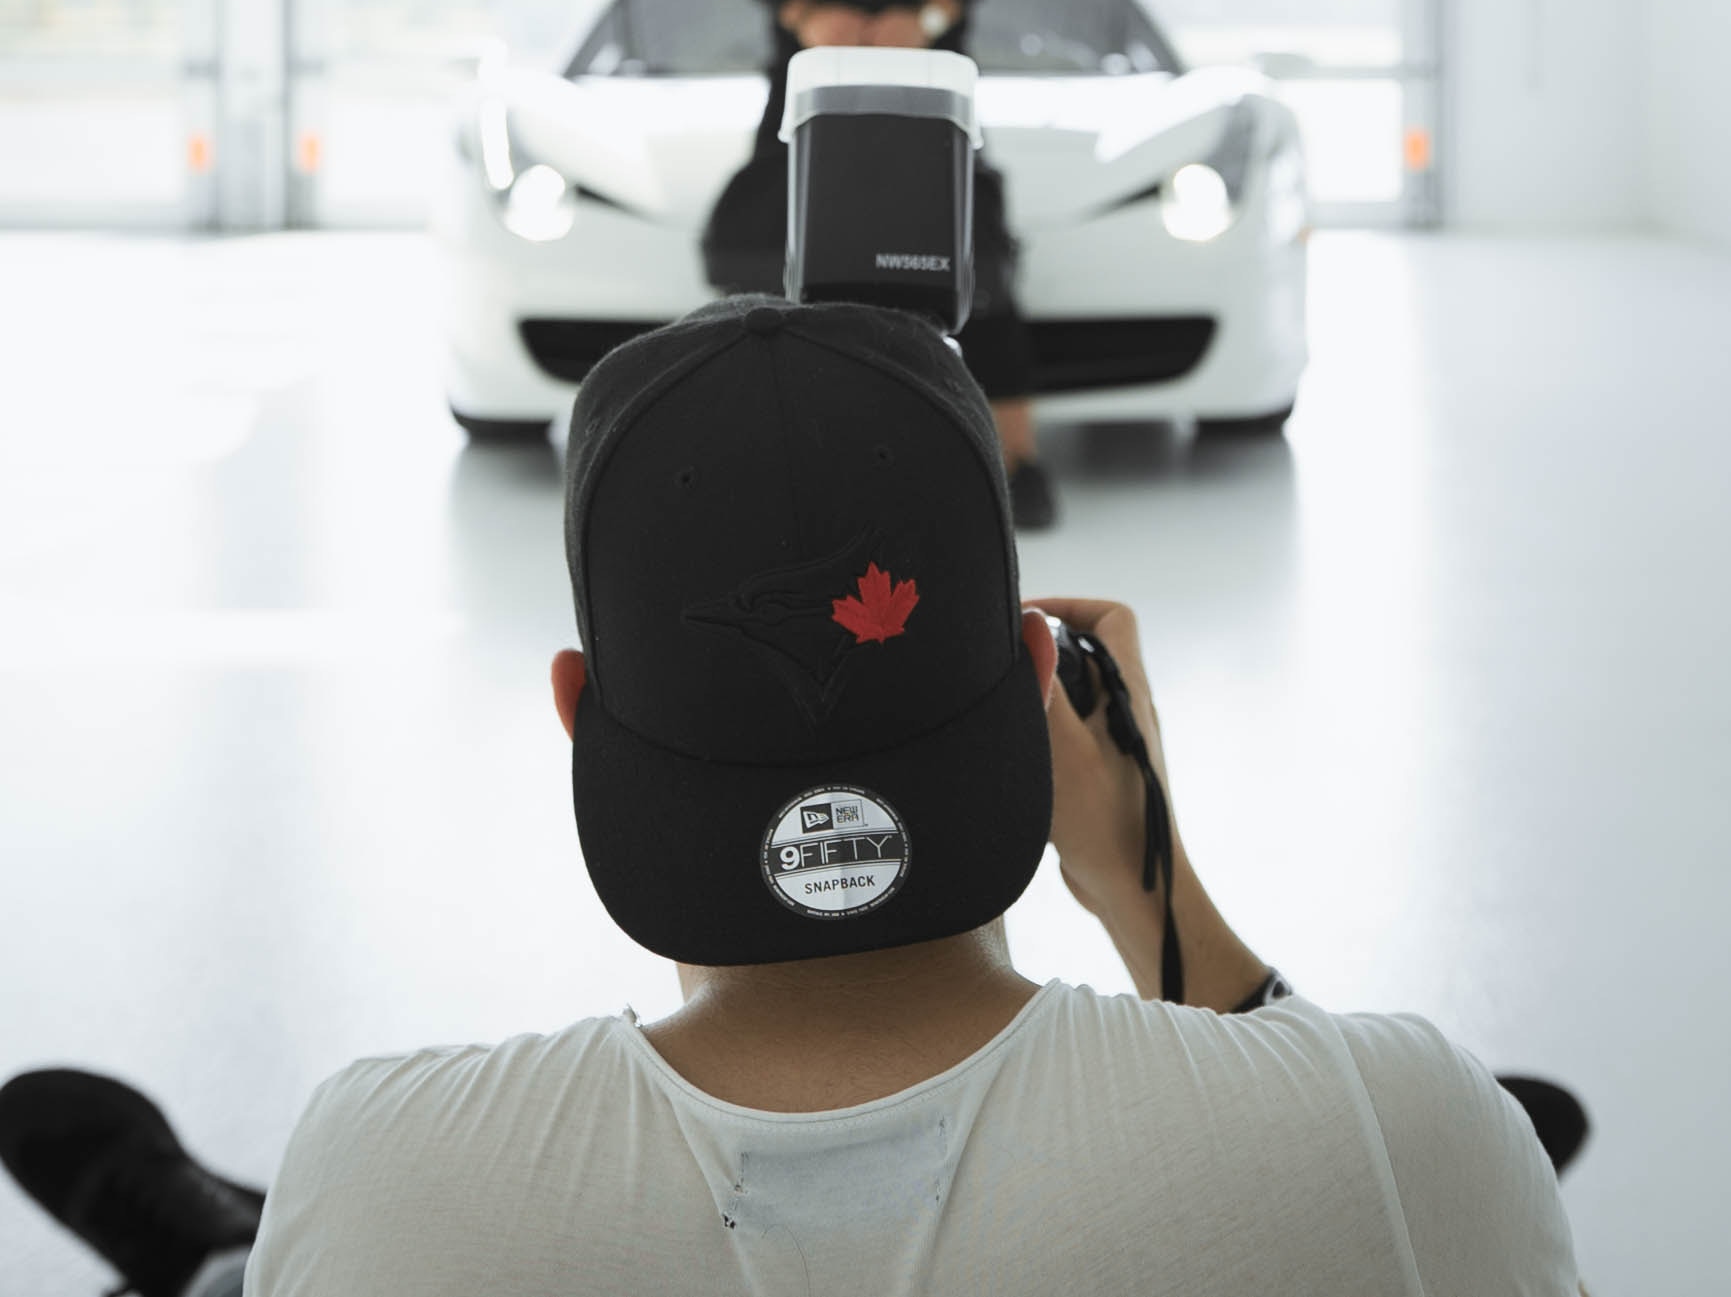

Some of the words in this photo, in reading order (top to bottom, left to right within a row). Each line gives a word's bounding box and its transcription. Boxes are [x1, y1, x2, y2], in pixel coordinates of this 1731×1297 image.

[836, 805, 858, 815] NEW
[836, 814, 860, 824] ERA
[779, 835, 889, 871] 9FIFTY
[804, 875, 876, 895] SNAPBACK
